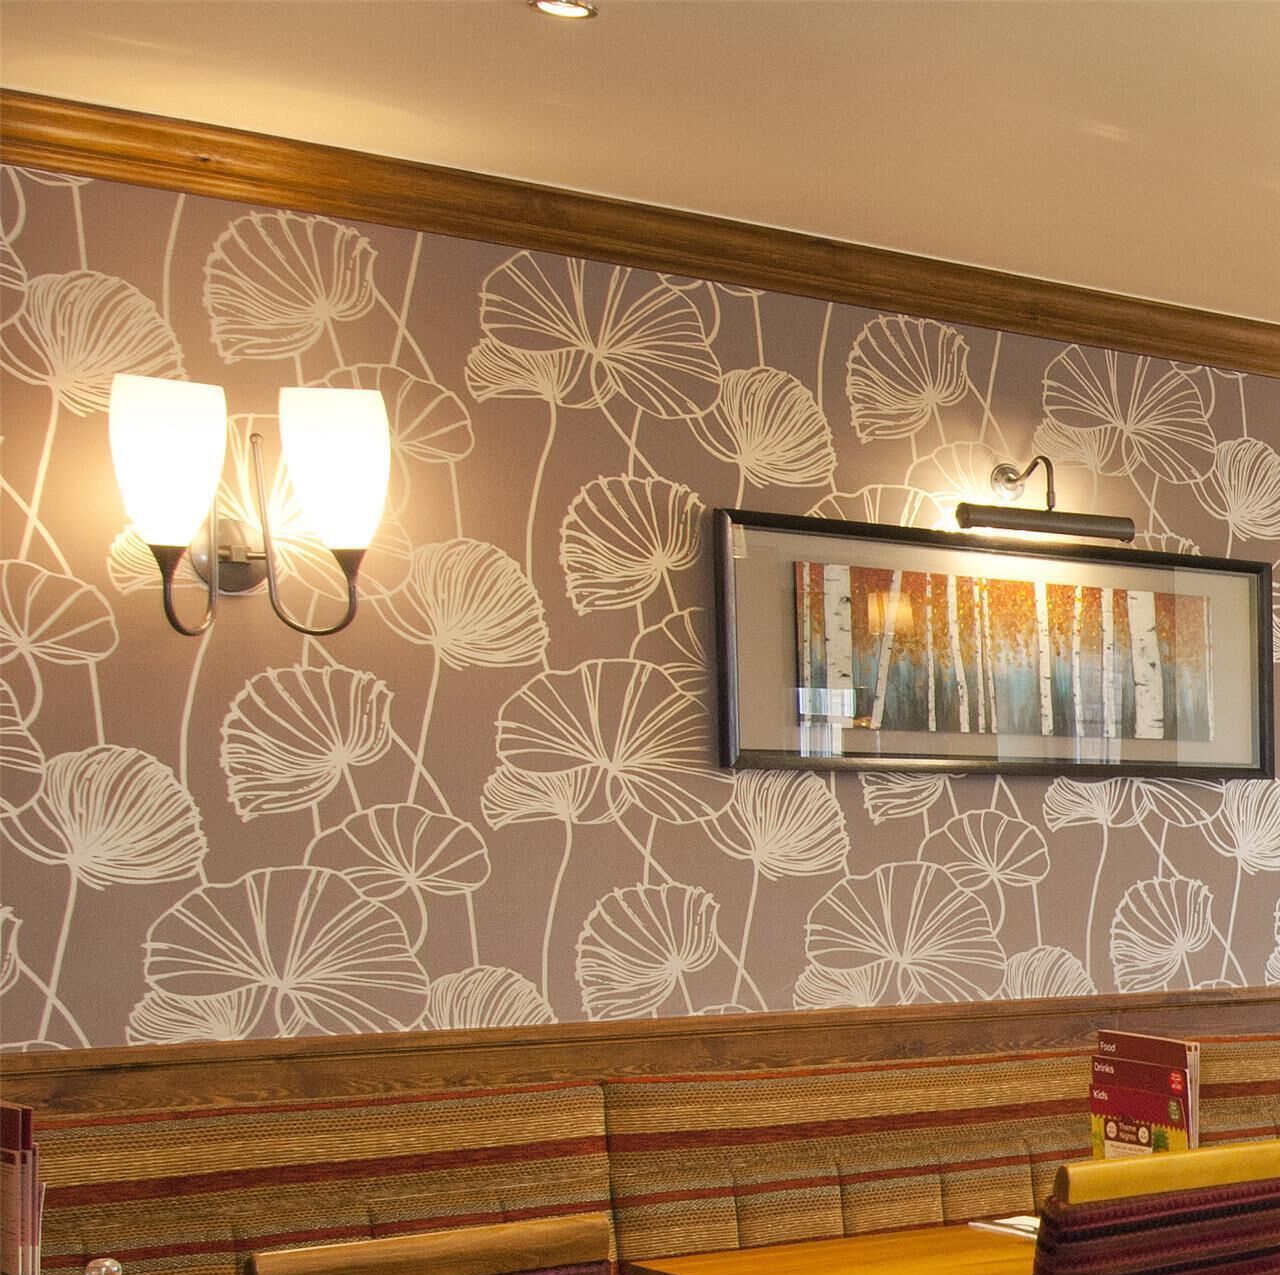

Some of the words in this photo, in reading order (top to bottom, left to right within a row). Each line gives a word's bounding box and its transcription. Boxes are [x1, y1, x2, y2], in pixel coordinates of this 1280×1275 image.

[1100, 1041, 1116, 1052] Food
[1094, 1062, 1114, 1074] Drinks
[1093, 1090, 1108, 1100] Kids
